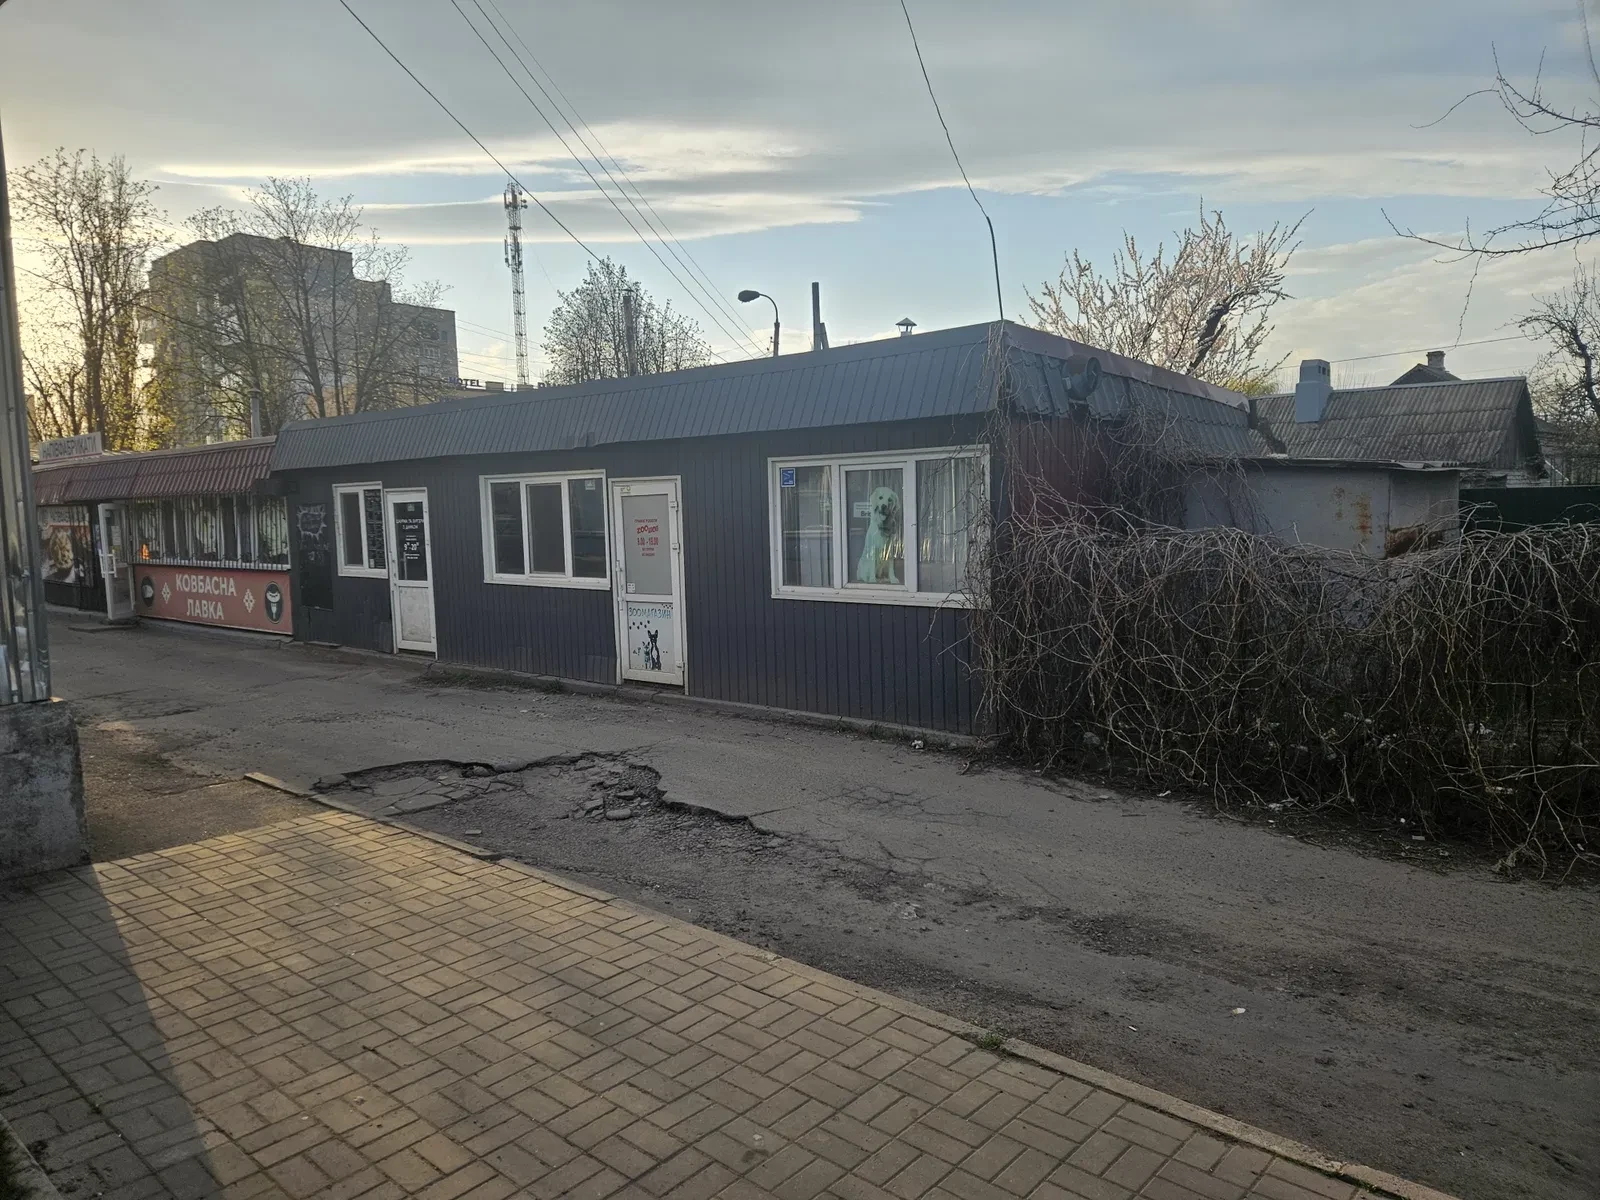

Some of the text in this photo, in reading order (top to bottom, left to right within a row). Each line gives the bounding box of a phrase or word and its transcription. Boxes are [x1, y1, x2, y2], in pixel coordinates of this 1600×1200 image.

[175, 573, 237, 597] КОВБАСНА
[186, 599, 224, 621] ЛАВКА
[629, 607, 672, 619] ЗООМАГАЗИН
